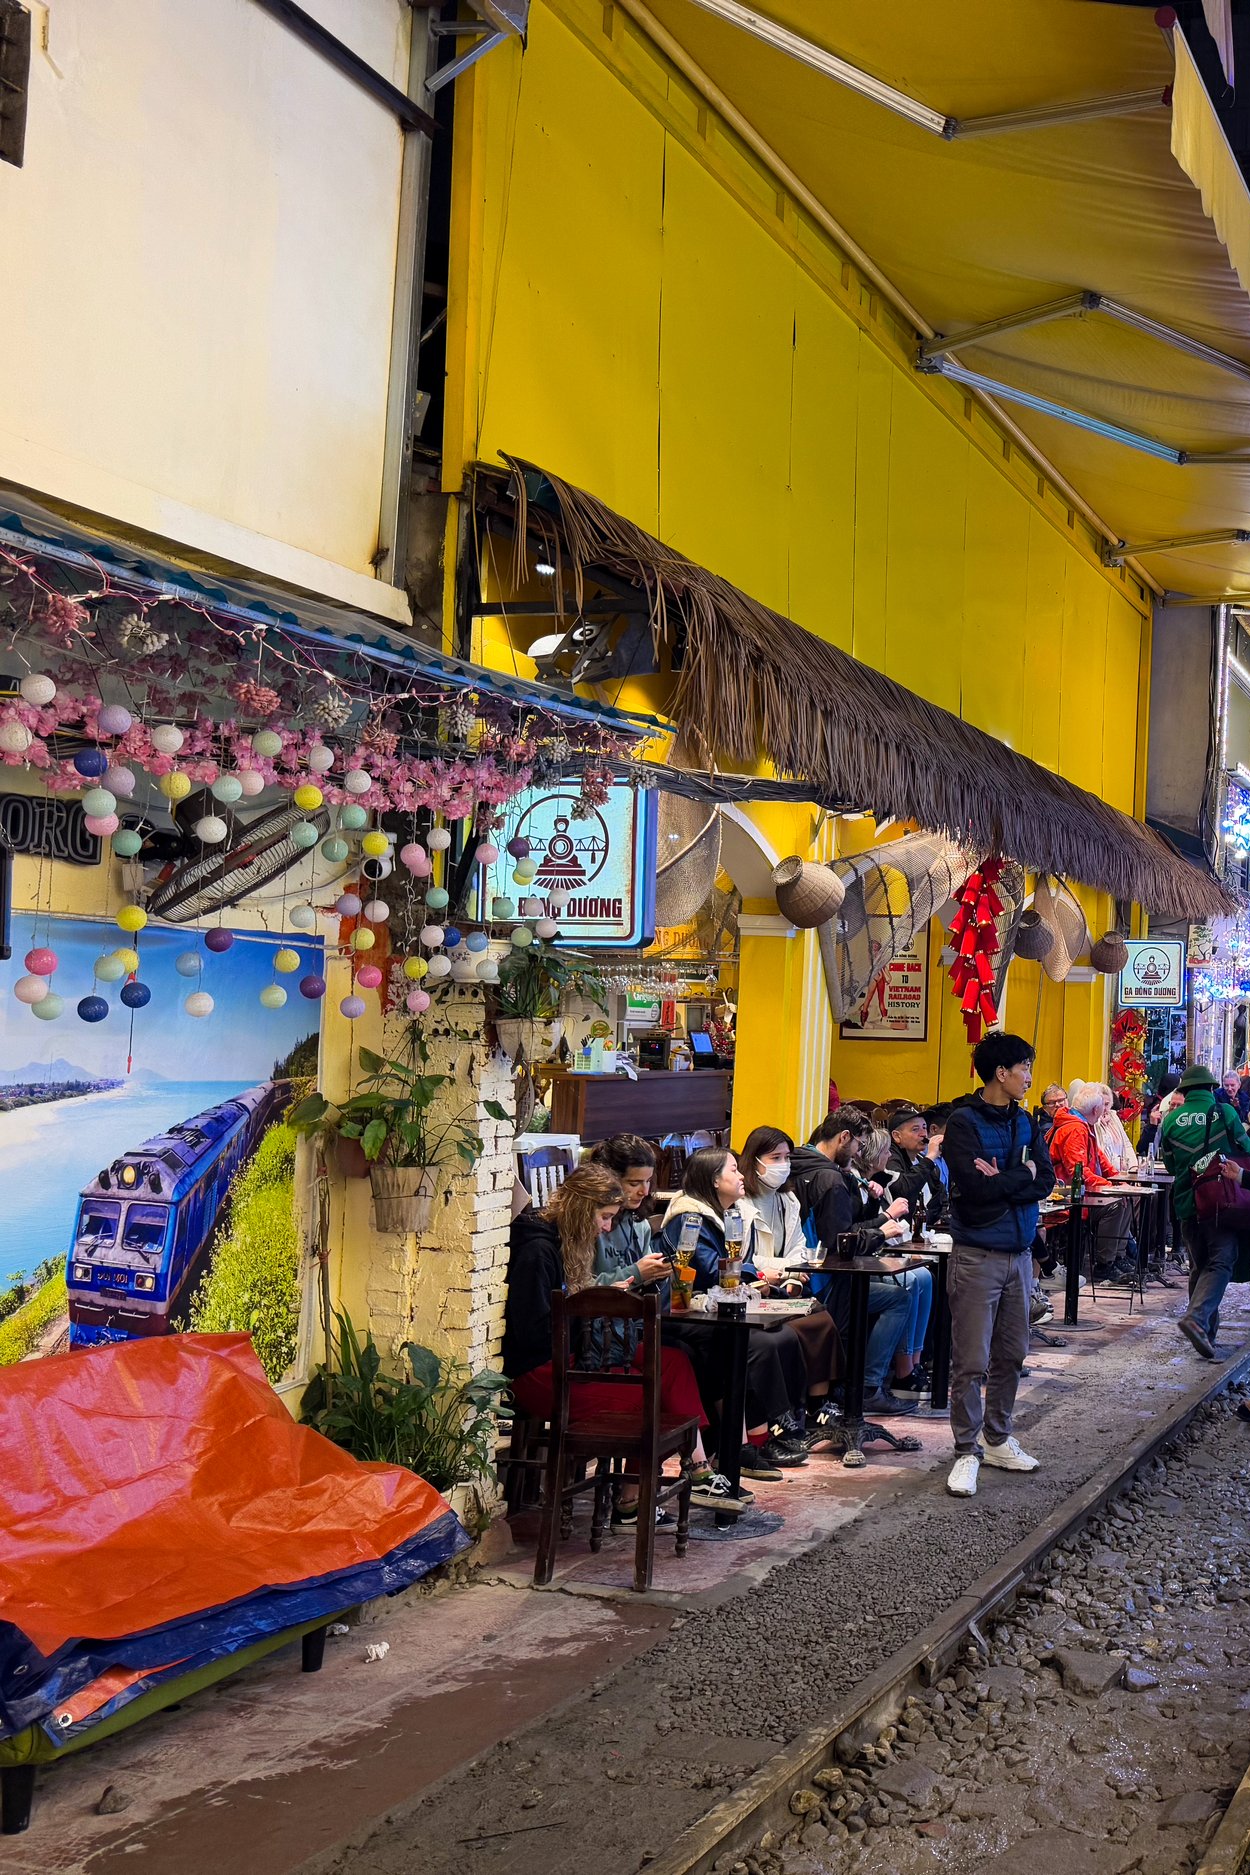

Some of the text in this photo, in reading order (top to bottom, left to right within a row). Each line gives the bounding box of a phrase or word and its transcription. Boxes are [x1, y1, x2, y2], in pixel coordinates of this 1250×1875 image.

[567, 896, 623, 918] DƯƠNG
[902, 975, 909, 984] TO
[1124, 987, 1133, 996] GA
